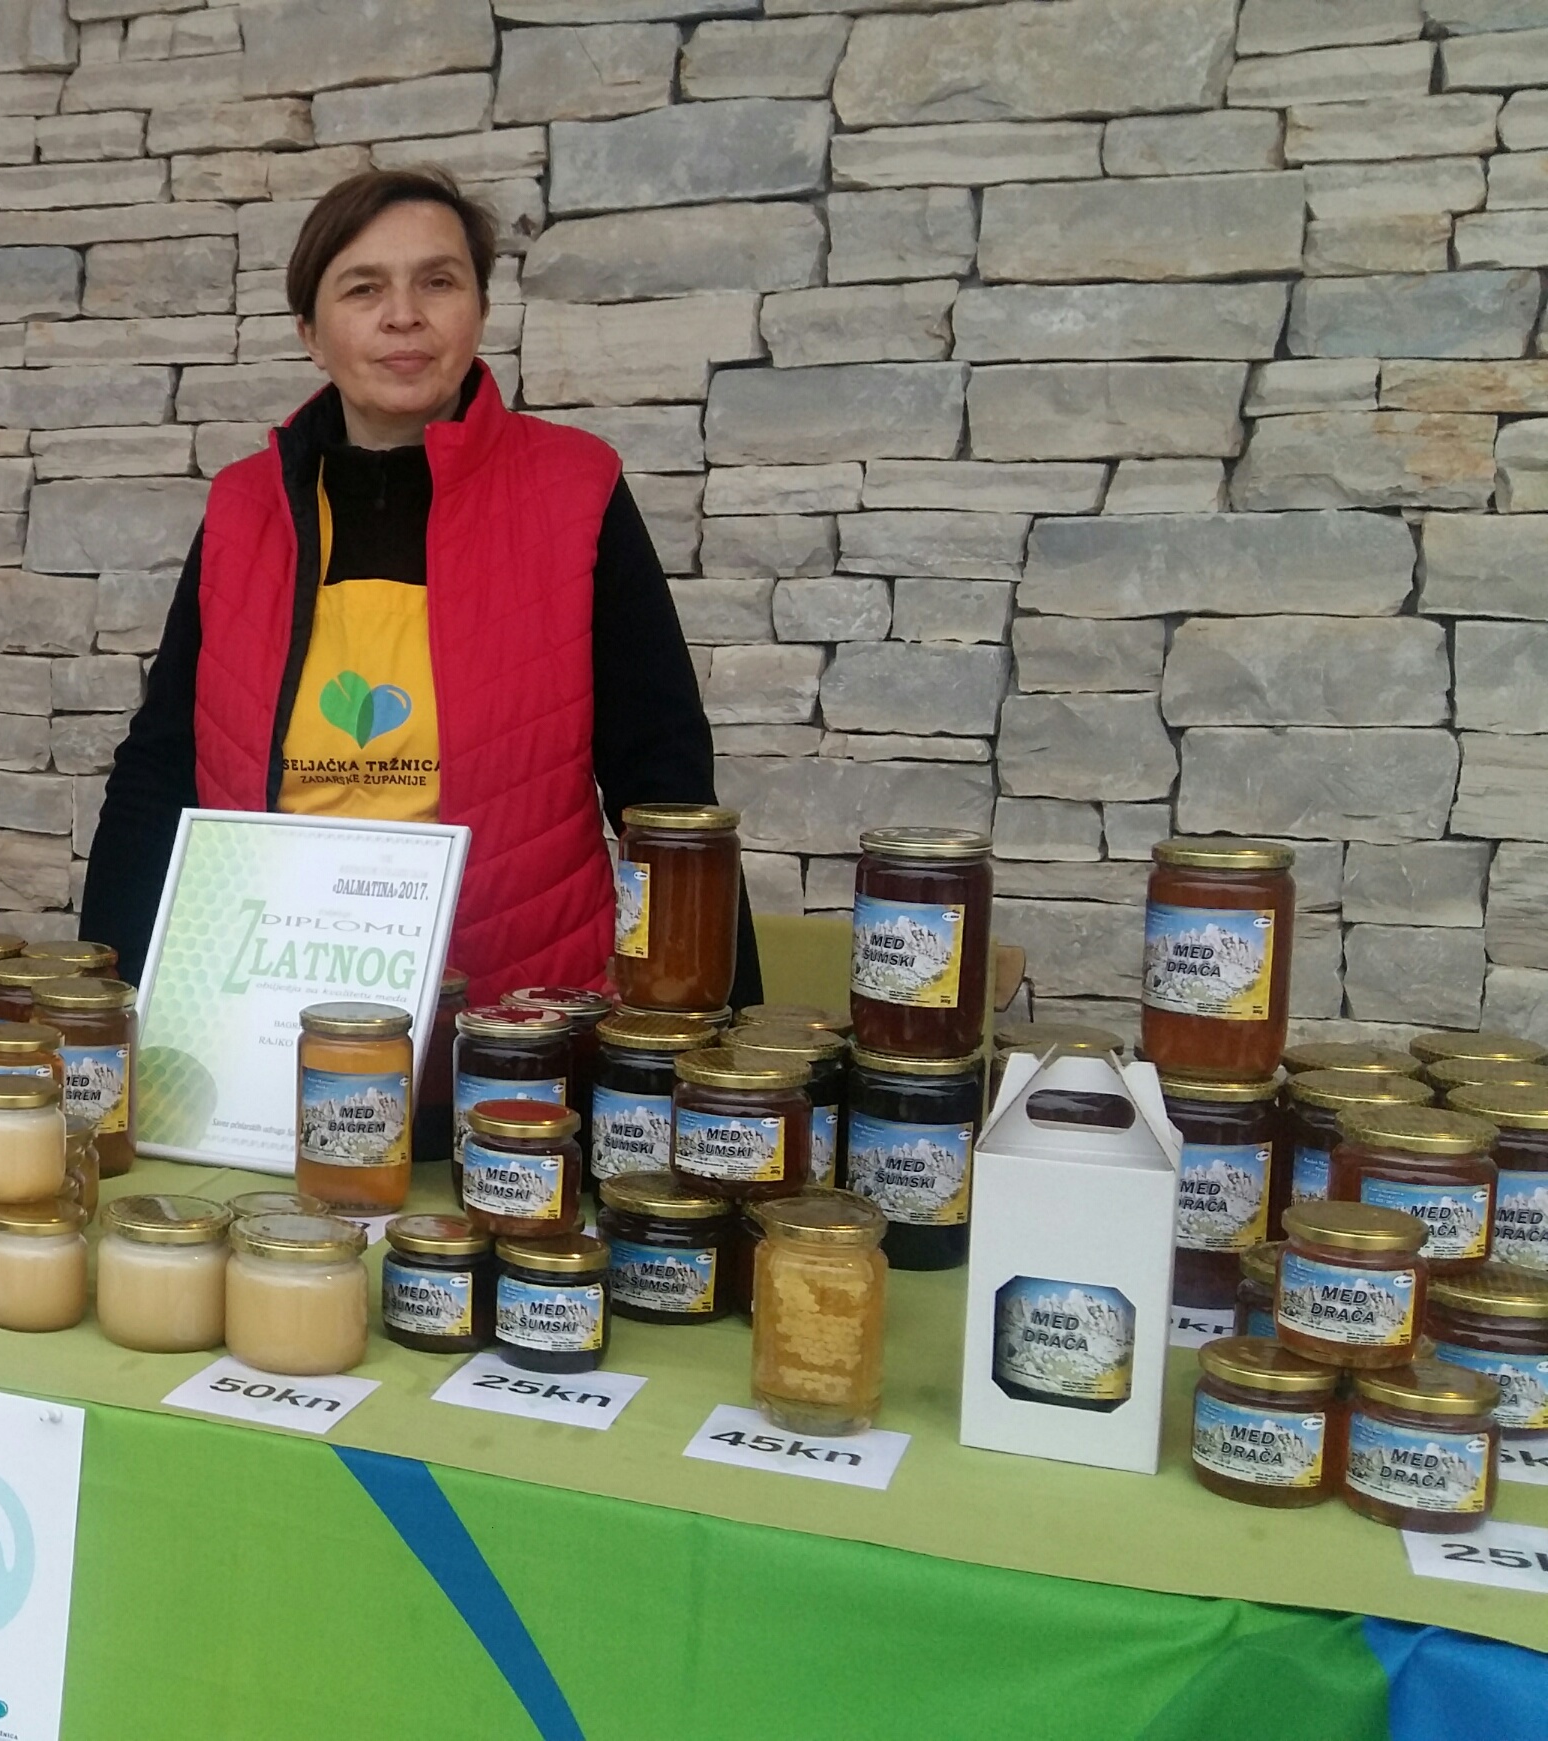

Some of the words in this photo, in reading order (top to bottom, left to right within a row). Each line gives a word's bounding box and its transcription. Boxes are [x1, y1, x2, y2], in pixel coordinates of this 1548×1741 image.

[283, 758, 360, 772] SELJAČKA
[300, 774, 360, 786] ZADARSKE
[363, 774, 427, 786] ŽUPANIJE
[398, 881, 428, 900] 2017.
[261, 913, 422, 938] DIPLOMU
[871, 934, 905, 950] MED
[1174, 944, 1214, 960] MED
[1167, 961, 1221, 977] DRAČA
[258, 1036, 294, 1048] RAJKO
[341, 1107, 374, 1119] MED
[329, 1121, 385, 1133] BAGREM
[611, 1124, 644, 1138] MED
[707, 1128, 741, 1142] MED
[886, 1158, 926, 1172] MED
[486, 1167, 519, 1183] MED
[875, 1167, 937, 1189] ŠUMSKI
[1180, 1180, 1221, 1196] MED
[1410, 1205, 1451, 1219] MED
[1499, 1209, 1543, 1224] MED
[641, 1263, 676, 1278] MED
[397, 1284, 429, 1300] MED
[1321, 1285, 1368, 1304] MED
[529, 1302, 566, 1316] MED
[1311, 1302, 1374, 1323] DRAČA
[519, 1315, 577, 1333] ŠUMSKI
[1032, 1311, 1079, 1331] MED
[1023, 1328, 1089, 1352] DRAČA
[208, 1375, 343, 1415] 50kn
[472, 1374, 612, 1408] 25kn
[1230, 1425, 1275, 1444] MED
[708, 1428, 864, 1468] 45kn
[1221, 1441, 1283, 1464] DRAČA
[1391, 1448, 1438, 1468] MED
[1379, 1465, 1447, 1489] DRAČA
